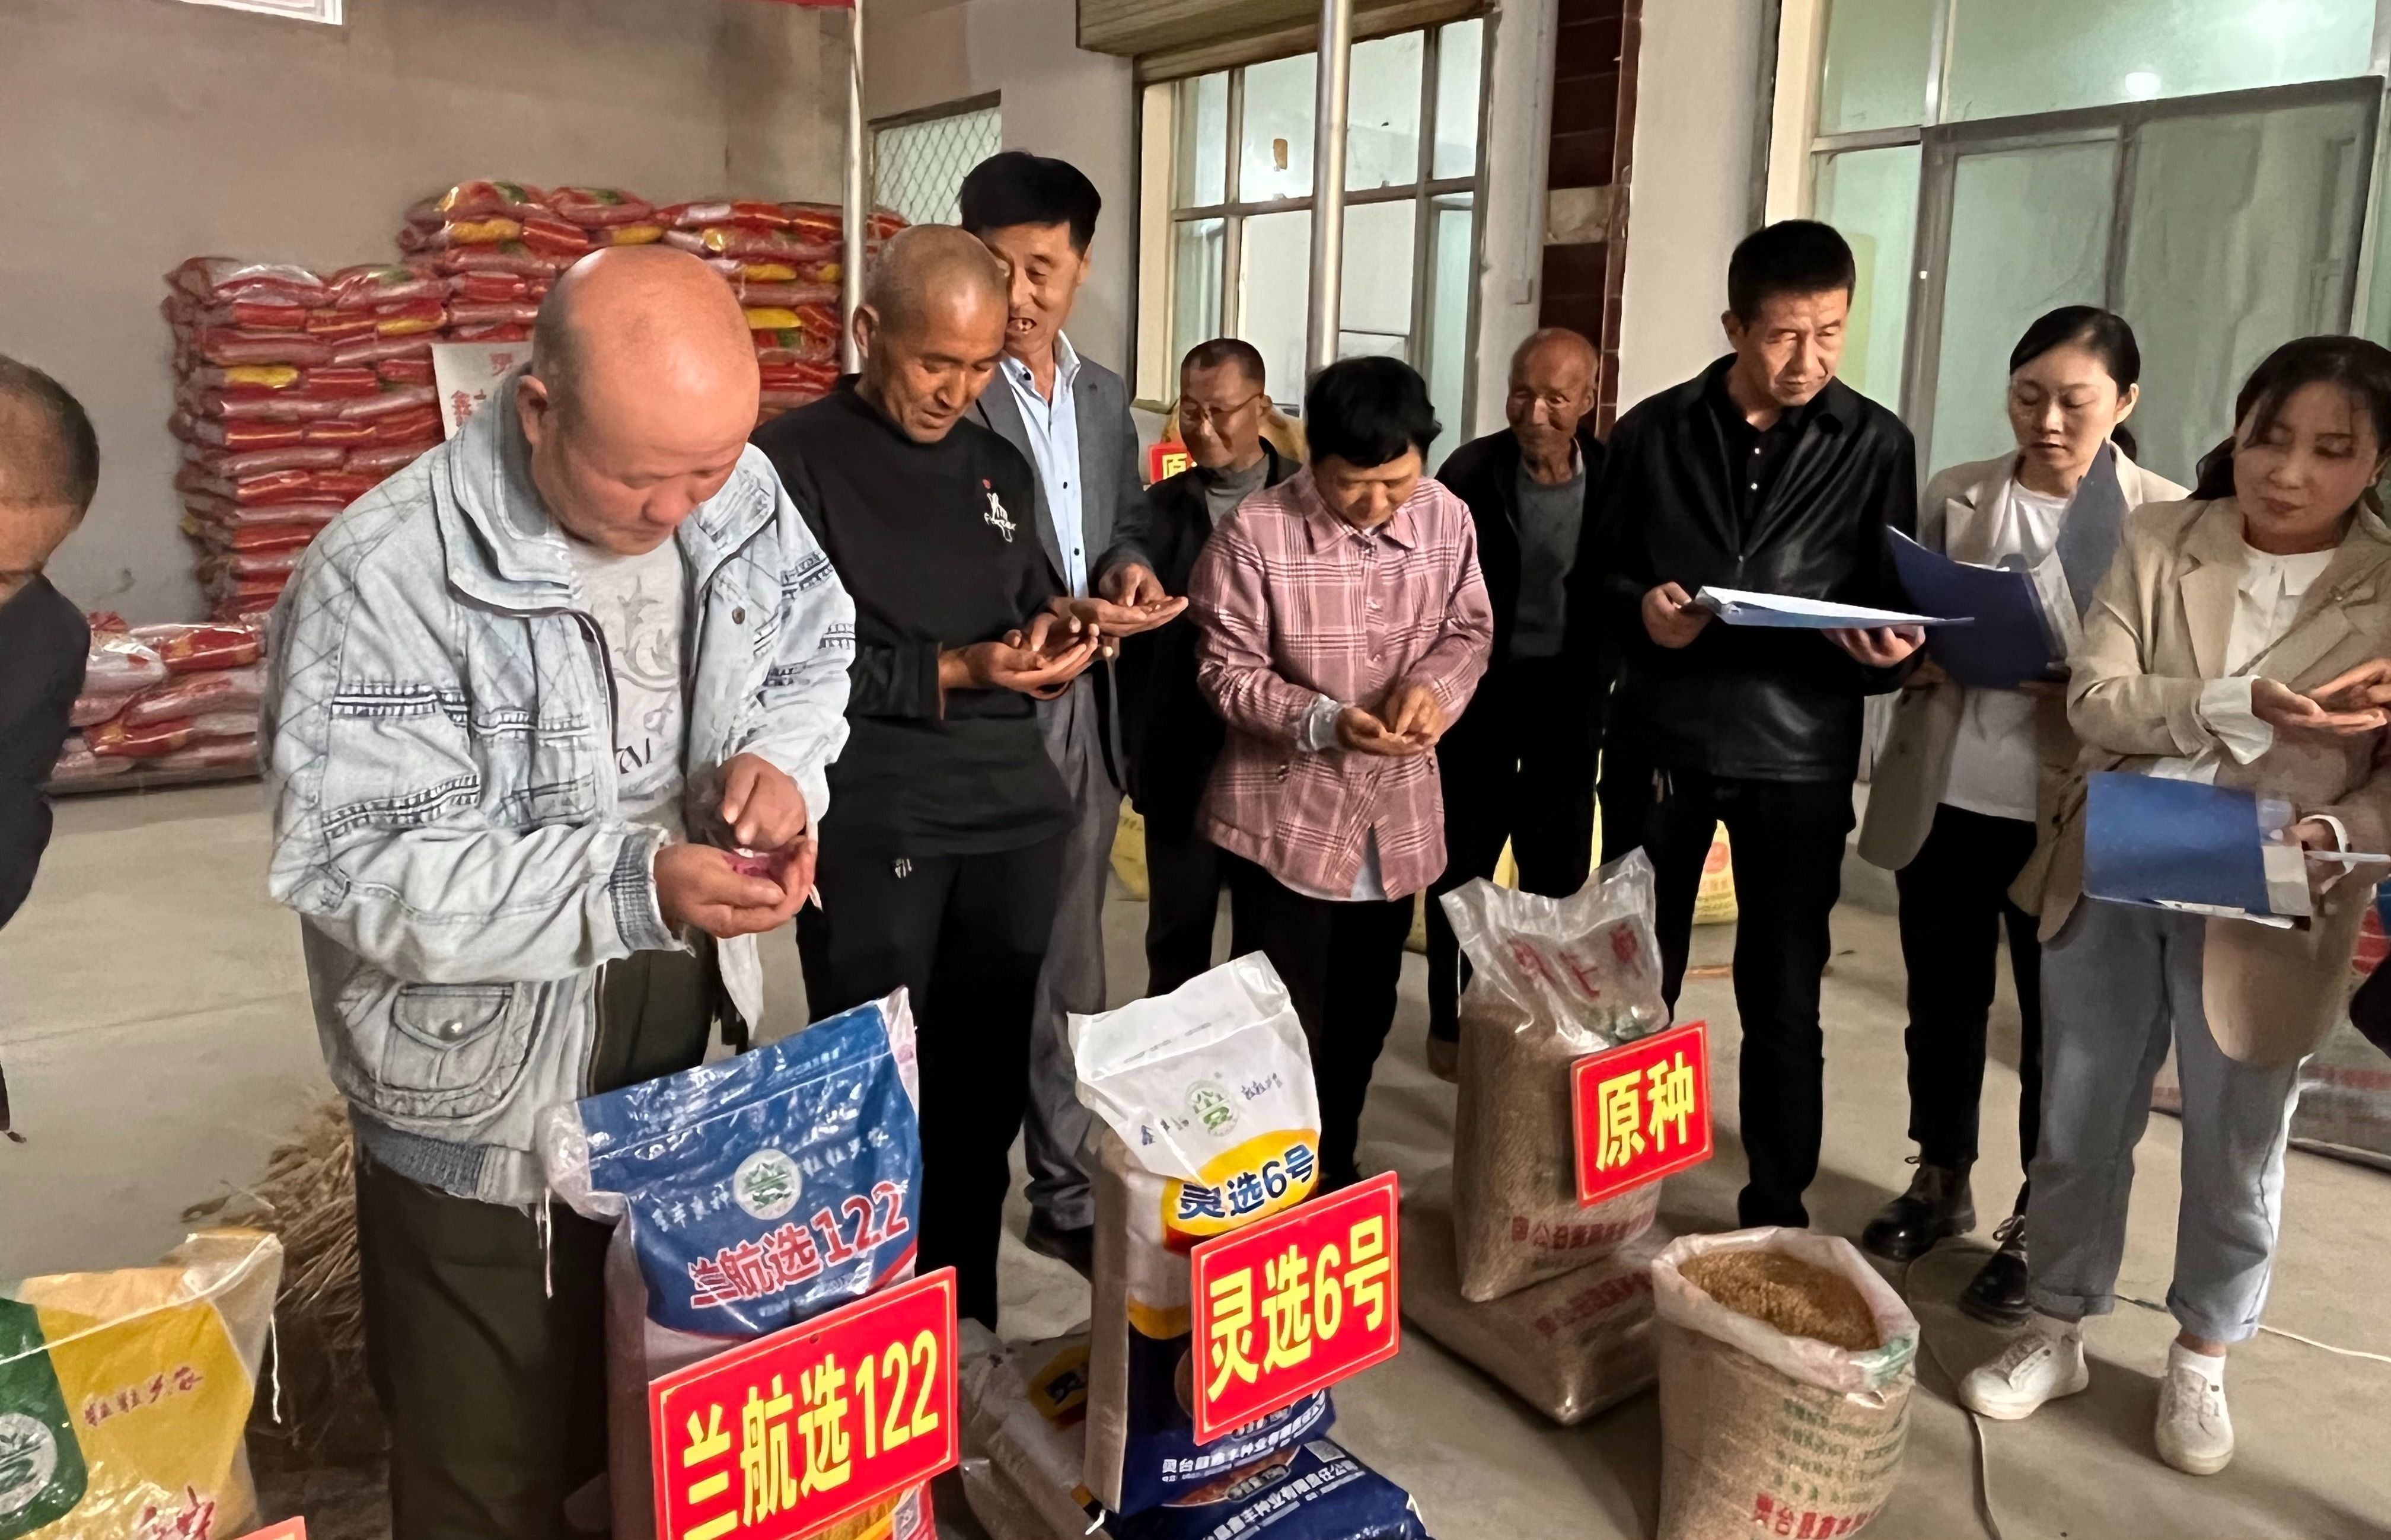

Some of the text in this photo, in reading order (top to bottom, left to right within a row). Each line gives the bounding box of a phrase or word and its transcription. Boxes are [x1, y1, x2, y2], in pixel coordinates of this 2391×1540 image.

[1596, 1052, 1695, 1172] 原种
[688, 1181, 909, 1309] 兰航选122
[1178, 1144, 1315, 1220] 灵选6号
[1207, 1210, 1391, 1401] 灵选6号
[683, 1329, 939, 1540] 兰航选122
